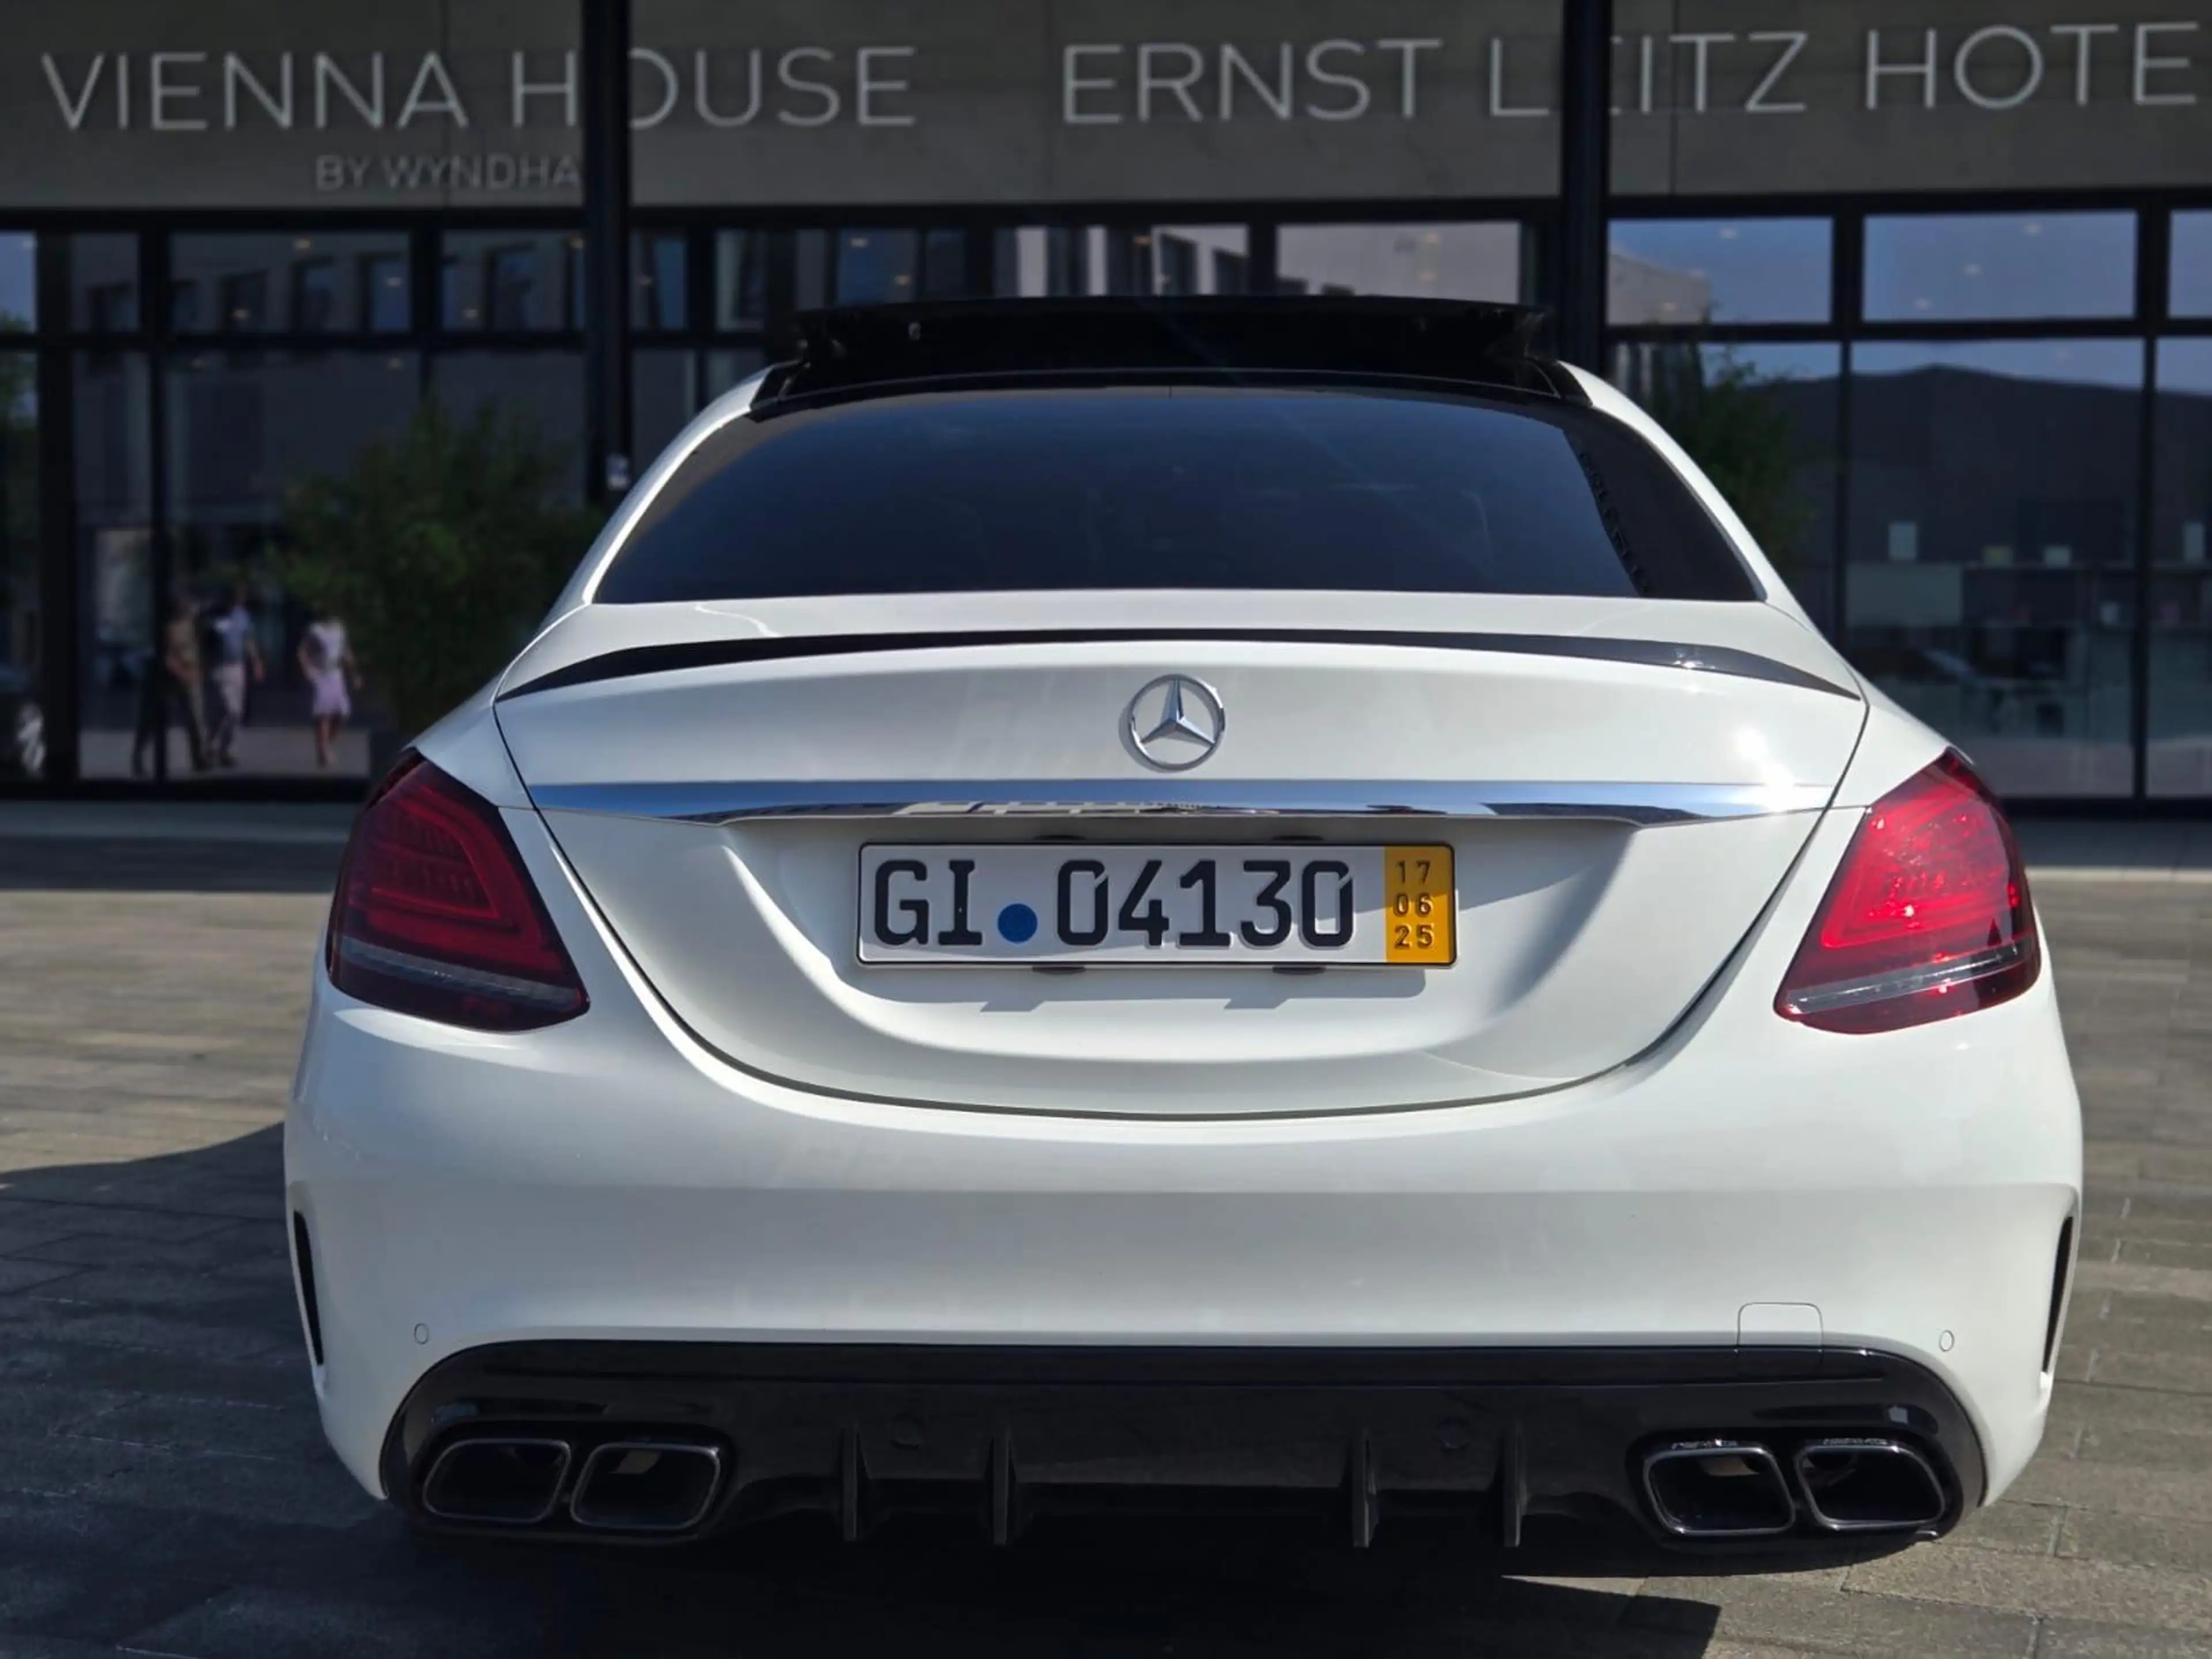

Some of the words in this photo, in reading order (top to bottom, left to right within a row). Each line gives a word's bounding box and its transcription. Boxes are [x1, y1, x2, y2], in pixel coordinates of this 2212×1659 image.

[40, 50, 469, 131] VIENNA
[512, 47, 916, 130] HOUSE
[1063, 37, 1442, 124] ERNST
[1490, 31, 1809, 116] LITZ
[1865, 21, 2199, 111] HOTE
[315, 154, 370, 190] BY
[1396, 859, 1431, 884] 17
[873, 858, 983, 946] GI
[1056, 858, 1354, 947] 04130
[1393, 892, 1432, 916] 06
[1393, 923, 1434, 949] 25
